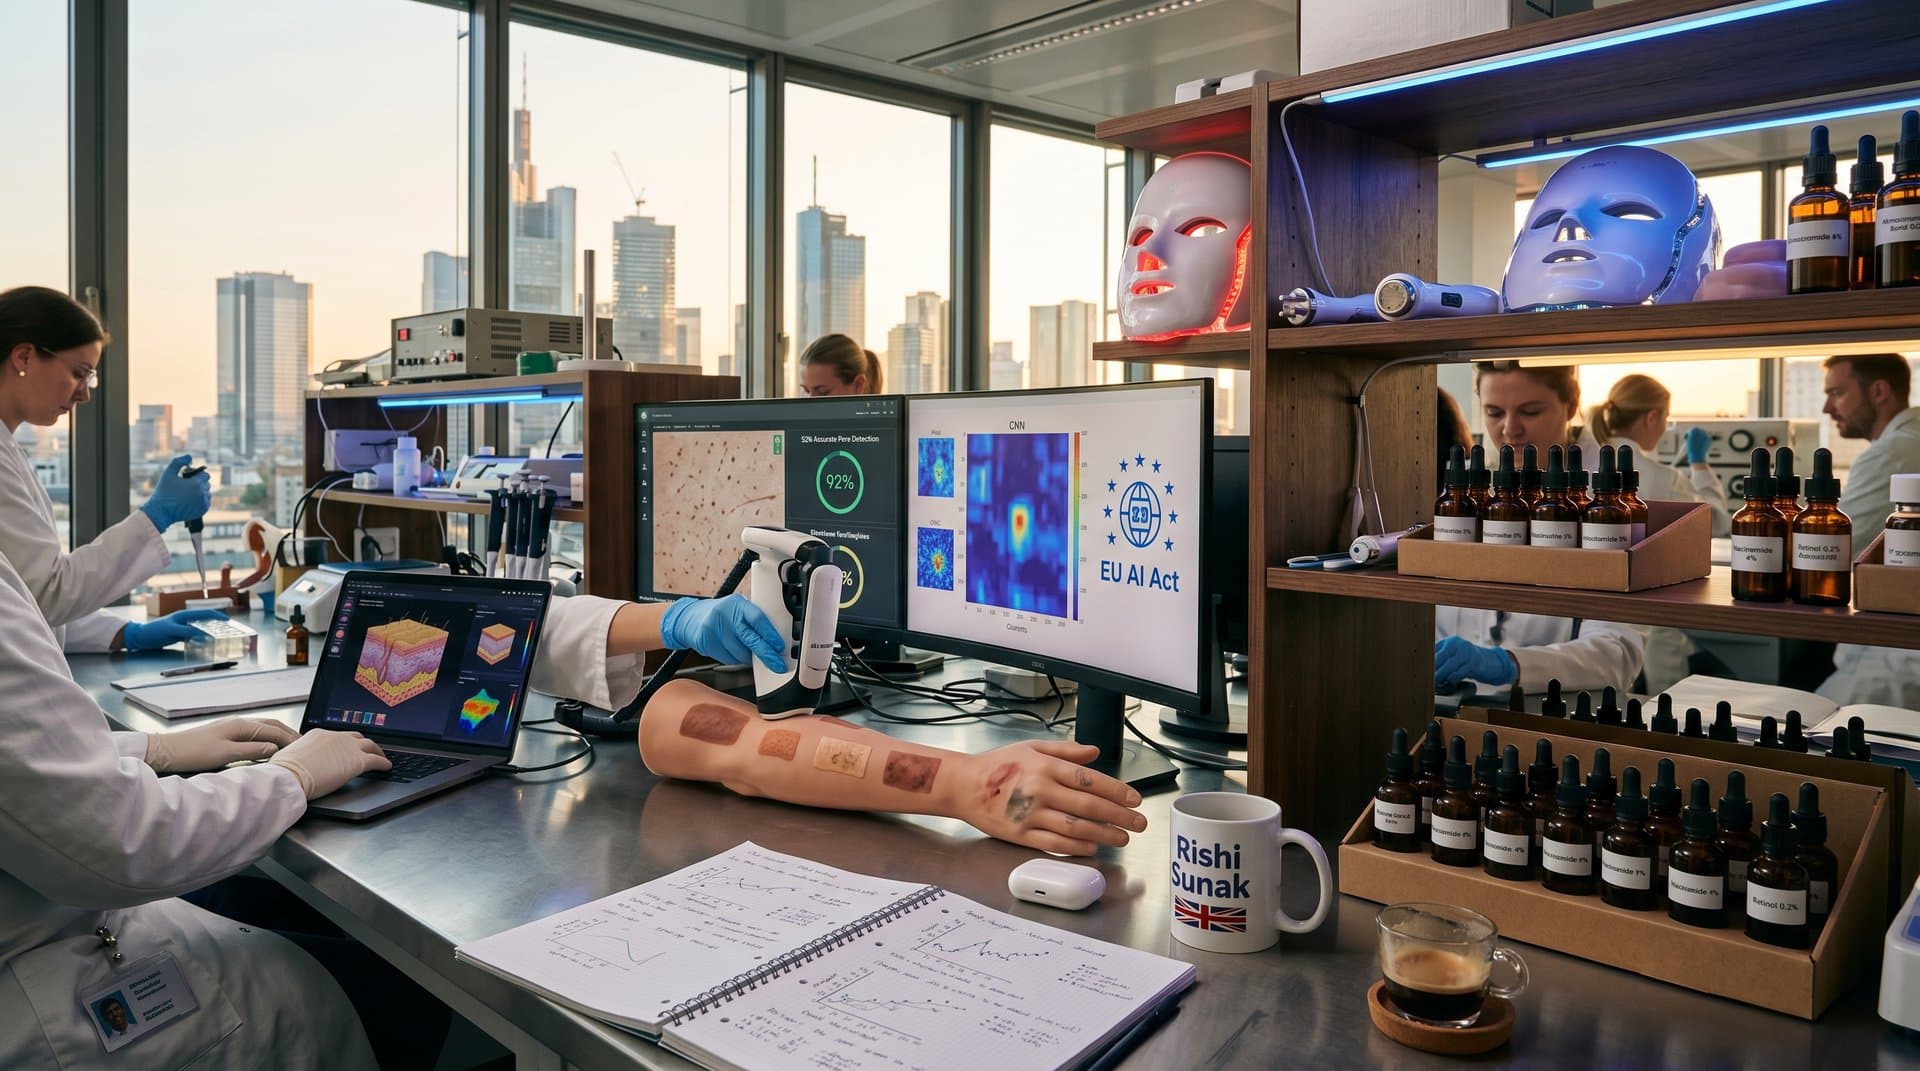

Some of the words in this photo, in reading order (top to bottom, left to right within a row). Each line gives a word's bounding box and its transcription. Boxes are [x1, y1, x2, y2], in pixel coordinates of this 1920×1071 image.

[1009, 420, 1025, 430] CNN
[826, 473, 855, 490] 92%
[1101, 560, 1122, 583] EU
[1127, 564, 1144, 587] AI
[1149, 566, 1179, 592] Act
[1177, 834, 1241, 870] Rishi
[1171, 861, 1251, 899] Sunak
[1752, 896, 1778, 911] Retinol
[1779, 903, 1799, 912] 0.2%
